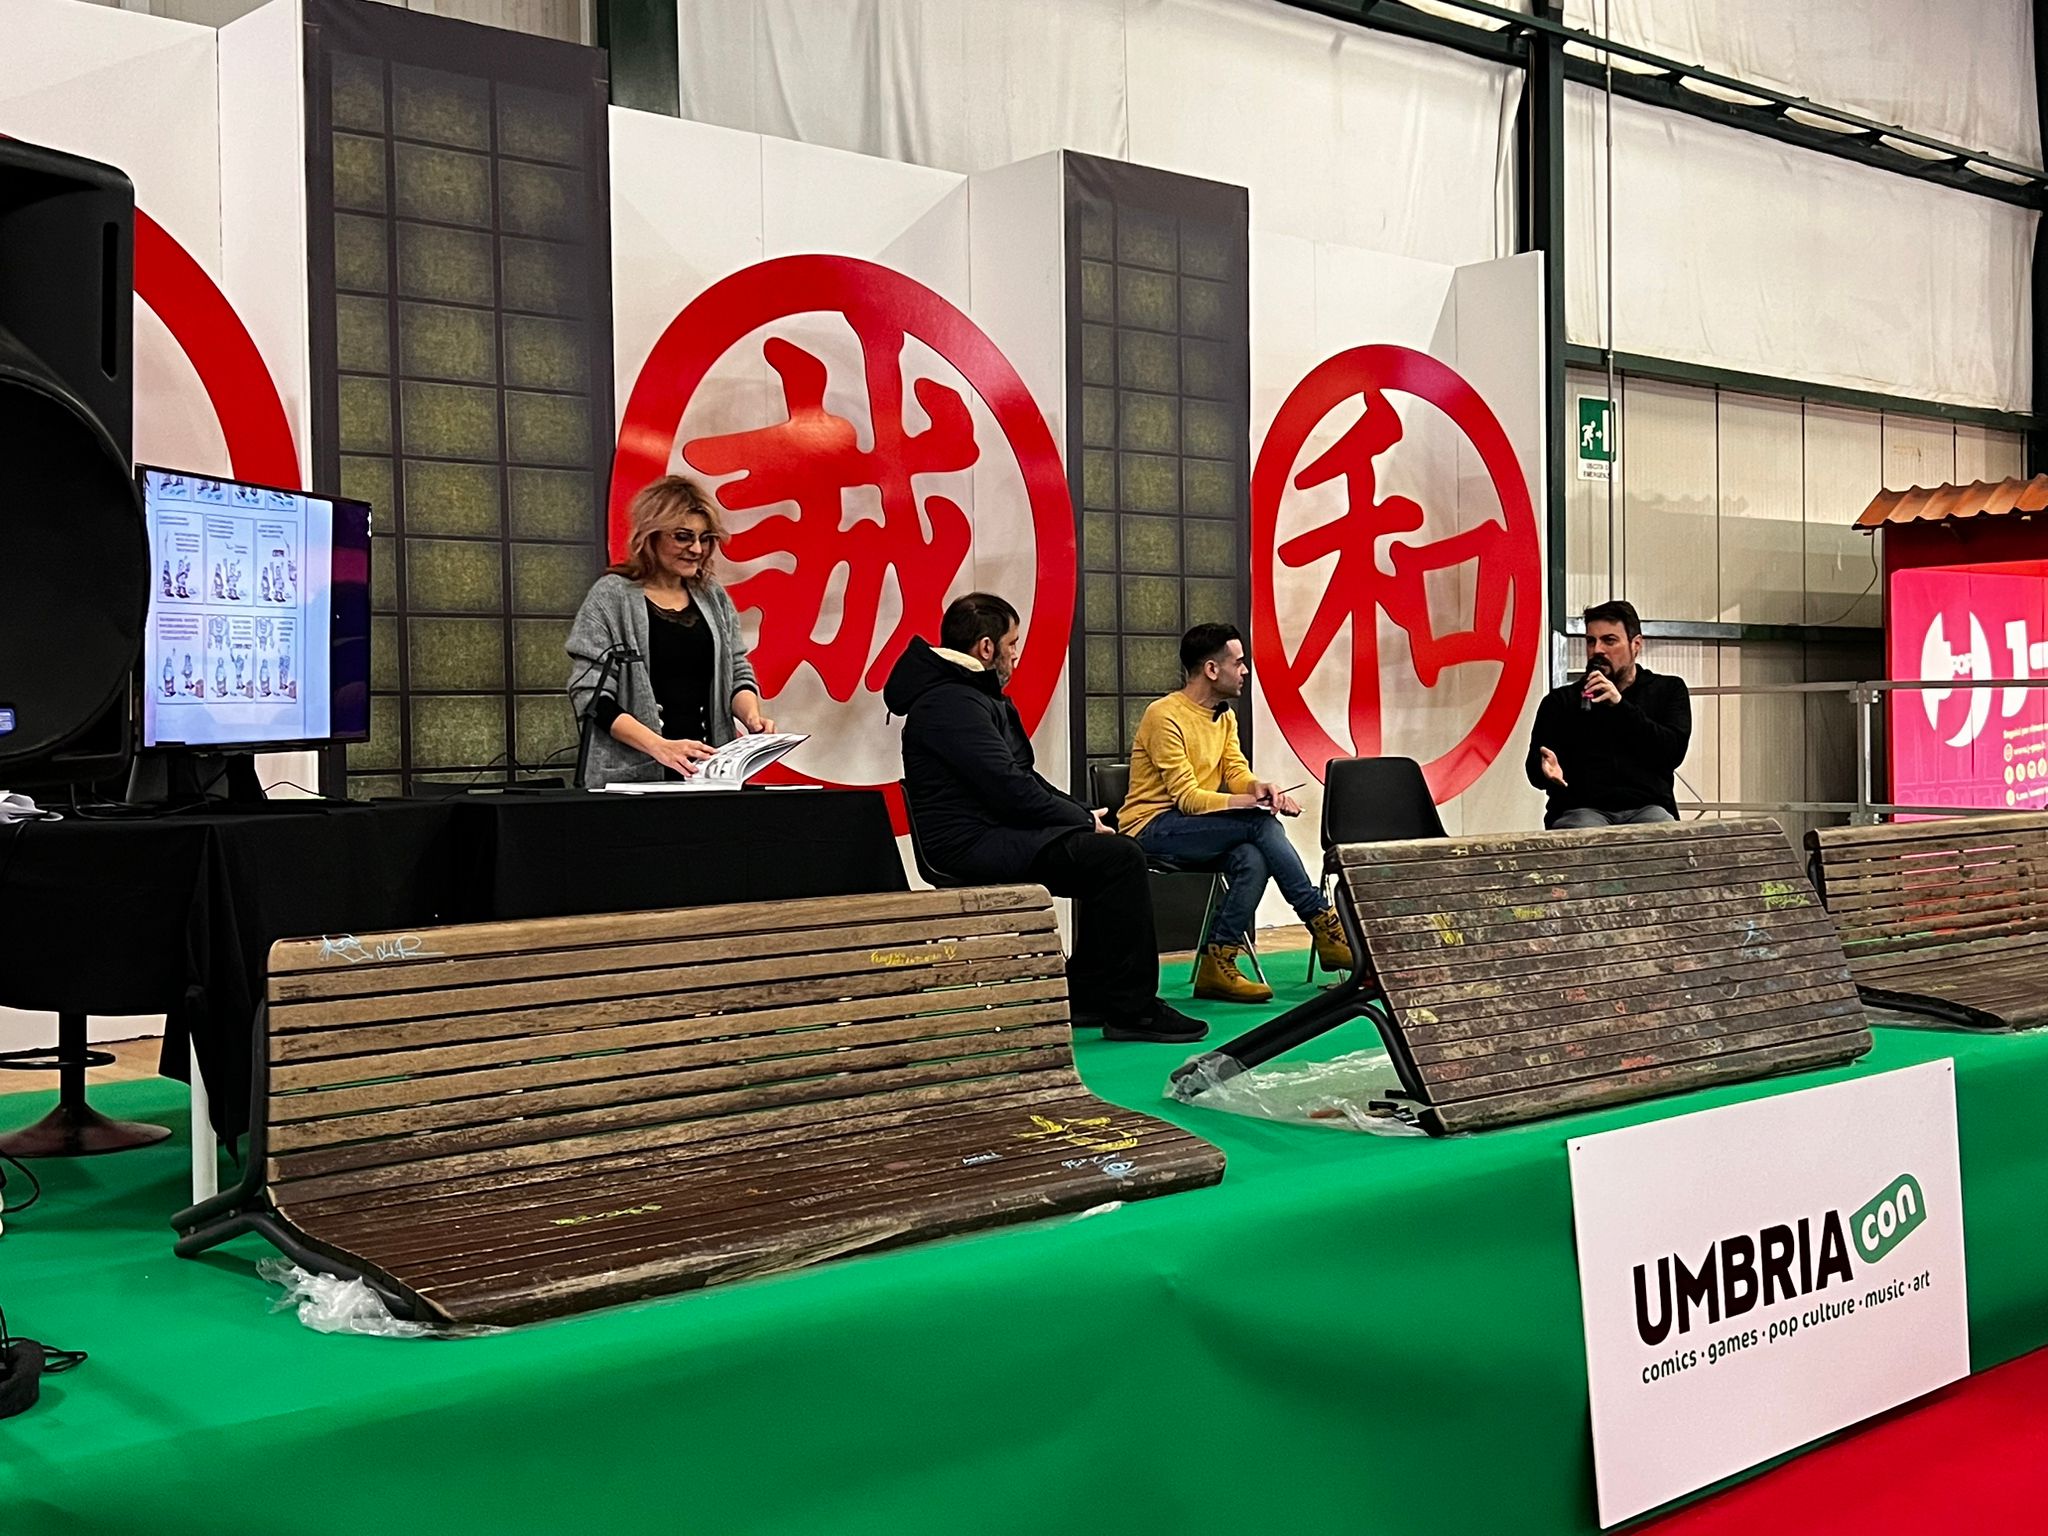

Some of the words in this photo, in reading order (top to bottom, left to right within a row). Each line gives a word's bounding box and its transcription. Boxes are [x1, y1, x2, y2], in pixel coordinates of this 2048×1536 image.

[1278, 388, 1513, 768] 和
[1632, 1209, 1854, 1346] UMBRIA
[1861, 1183, 1917, 1252] con
[1641, 1350, 1698, 1384] comics
[1707, 1328, 1759, 1365] games
[1768, 1315, 1799, 1345] pop
[1802, 1297, 1856, 1328] culture
[1864, 1278, 1906, 1309] music
[1912, 1269, 1931, 1291] art
